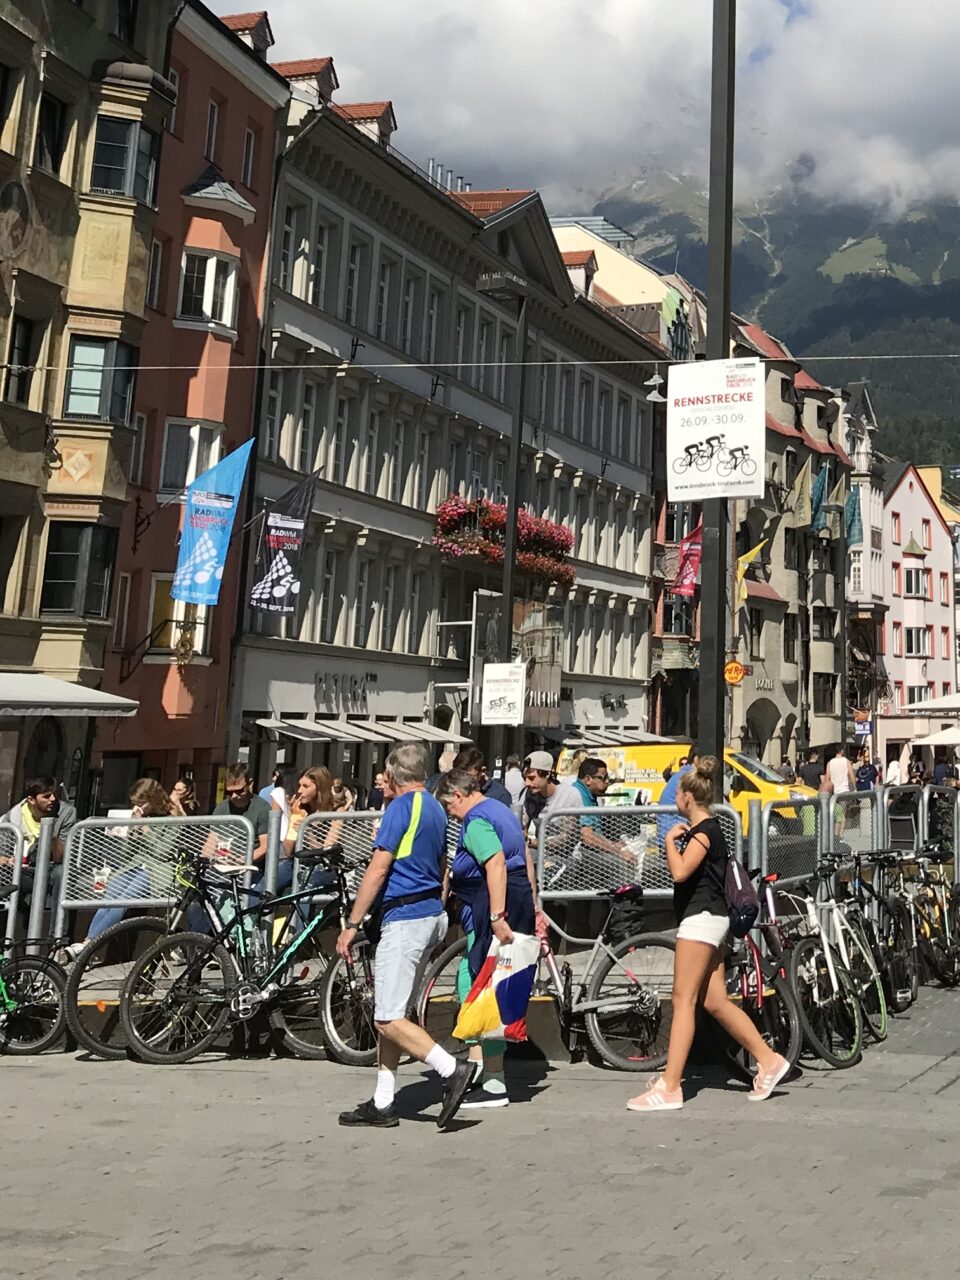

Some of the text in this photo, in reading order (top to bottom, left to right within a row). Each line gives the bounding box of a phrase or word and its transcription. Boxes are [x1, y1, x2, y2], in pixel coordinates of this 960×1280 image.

[674, 392, 753, 408] RENNSTRECKE
[271, 528, 297, 538] RADWM
[283, 542, 298, 551] 2018
